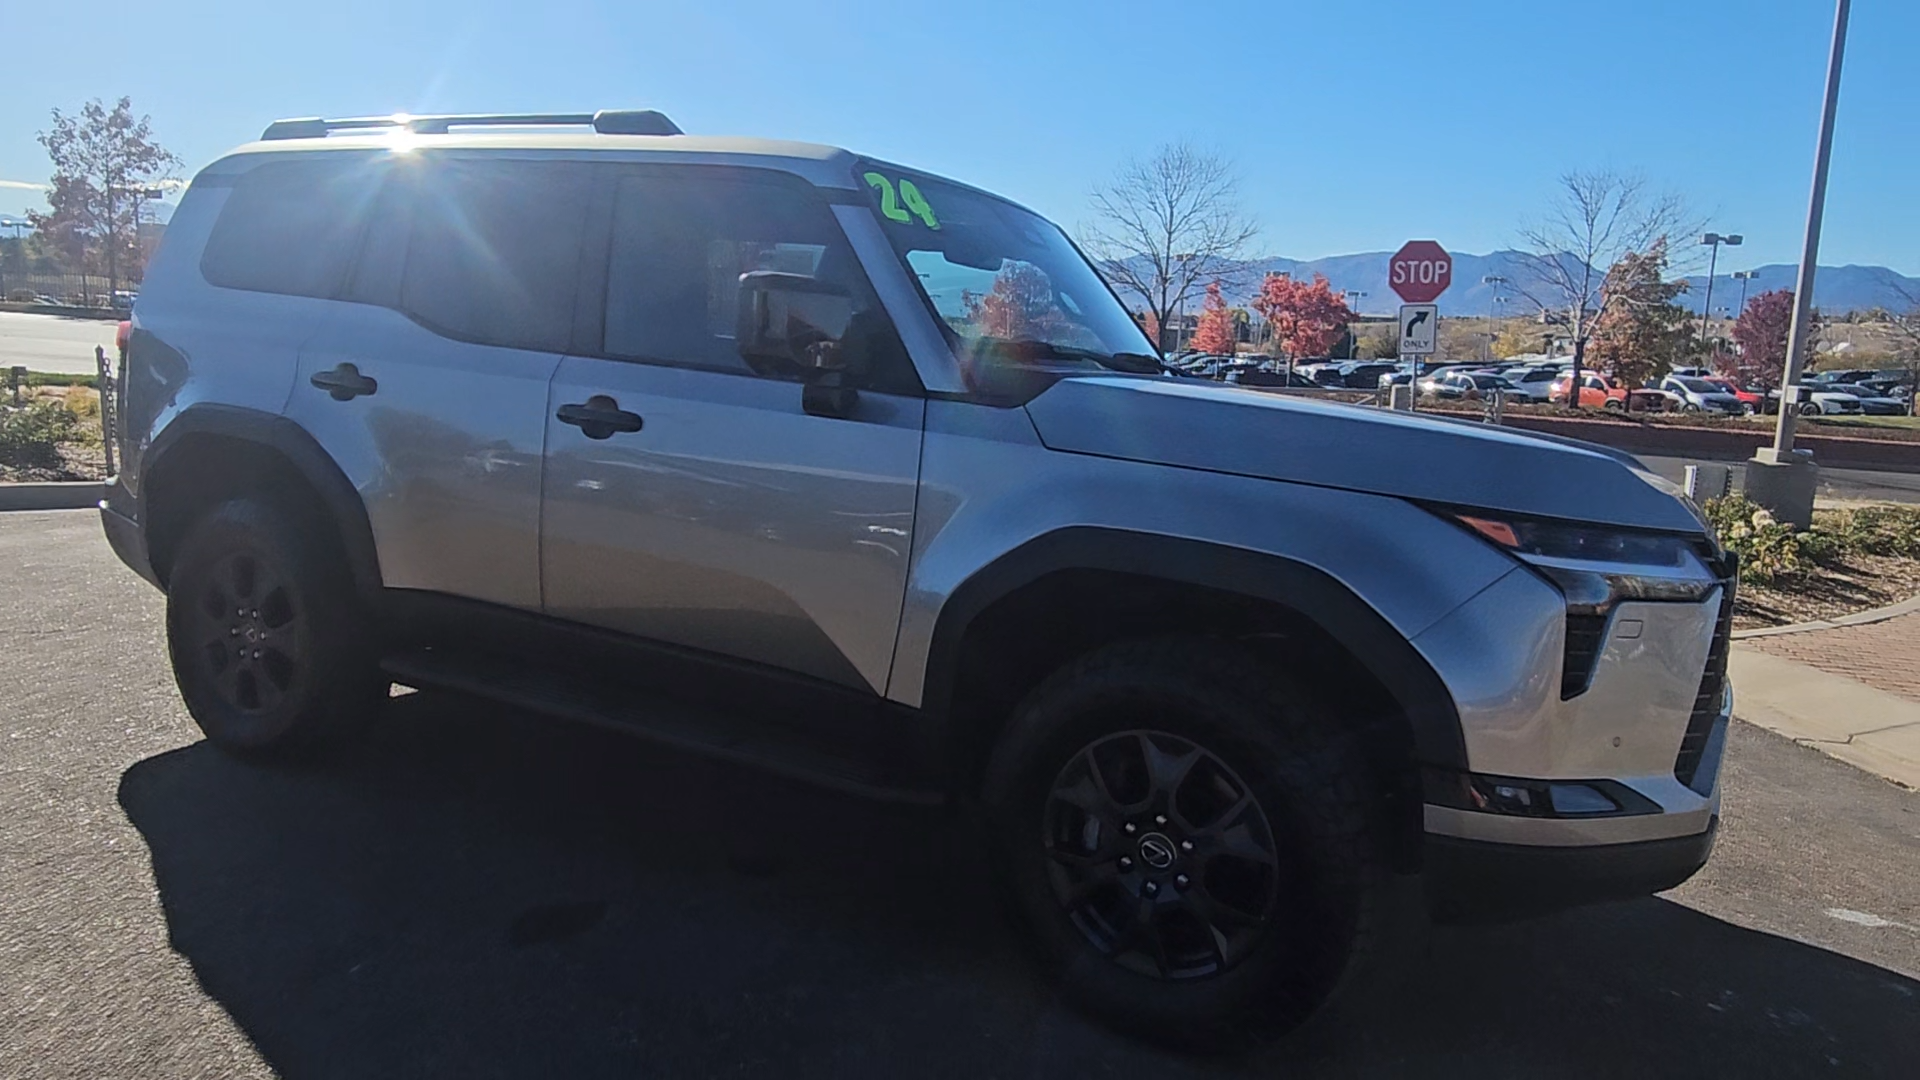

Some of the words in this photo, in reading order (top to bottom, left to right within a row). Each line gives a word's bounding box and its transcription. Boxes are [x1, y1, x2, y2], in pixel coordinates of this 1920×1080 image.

[863, 172, 937, 228] 24
[1392, 260, 1448, 284] STOP
[1403, 340, 1429, 349] ONLY
